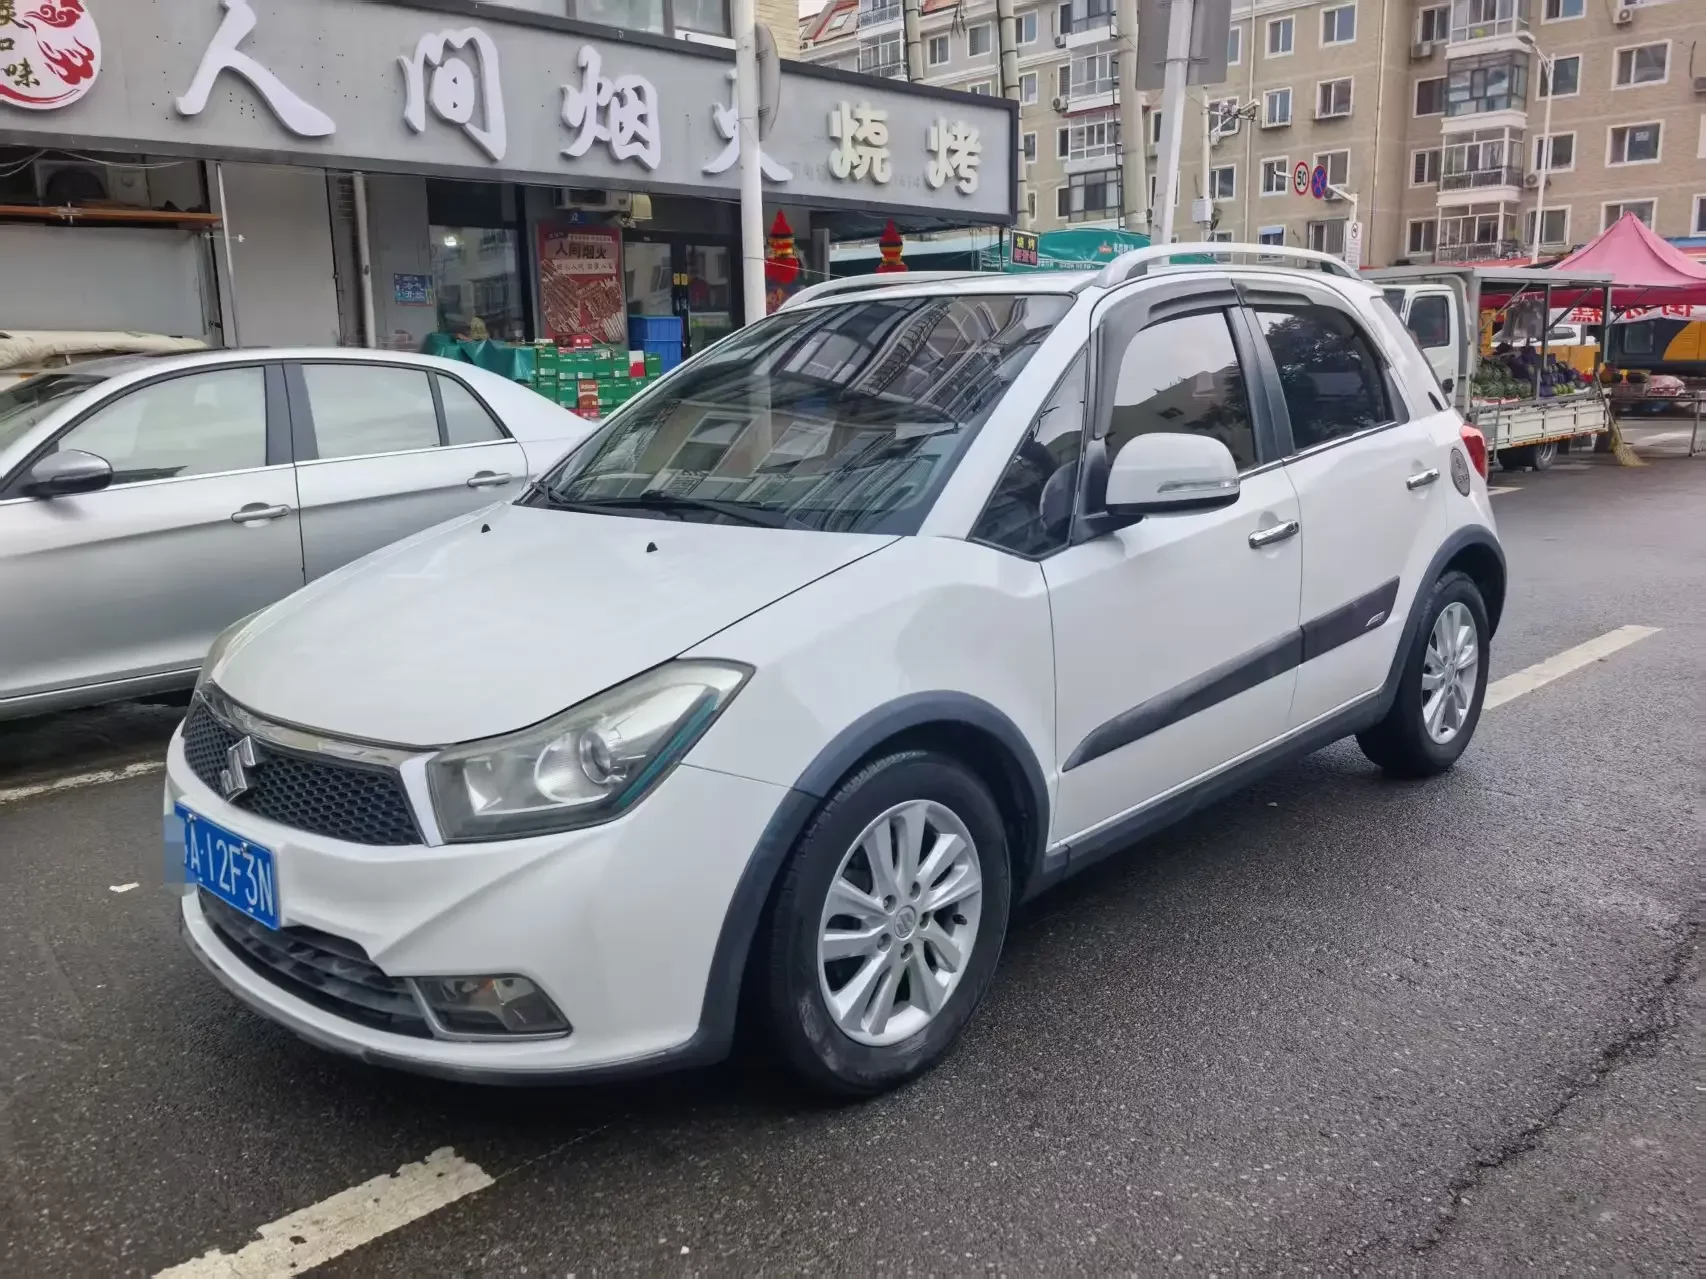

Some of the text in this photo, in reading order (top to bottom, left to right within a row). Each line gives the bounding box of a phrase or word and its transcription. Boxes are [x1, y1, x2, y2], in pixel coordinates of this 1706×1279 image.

[1297, 171, 1307, 186] 50
[556, 242, 607, 259] 人间烟火
